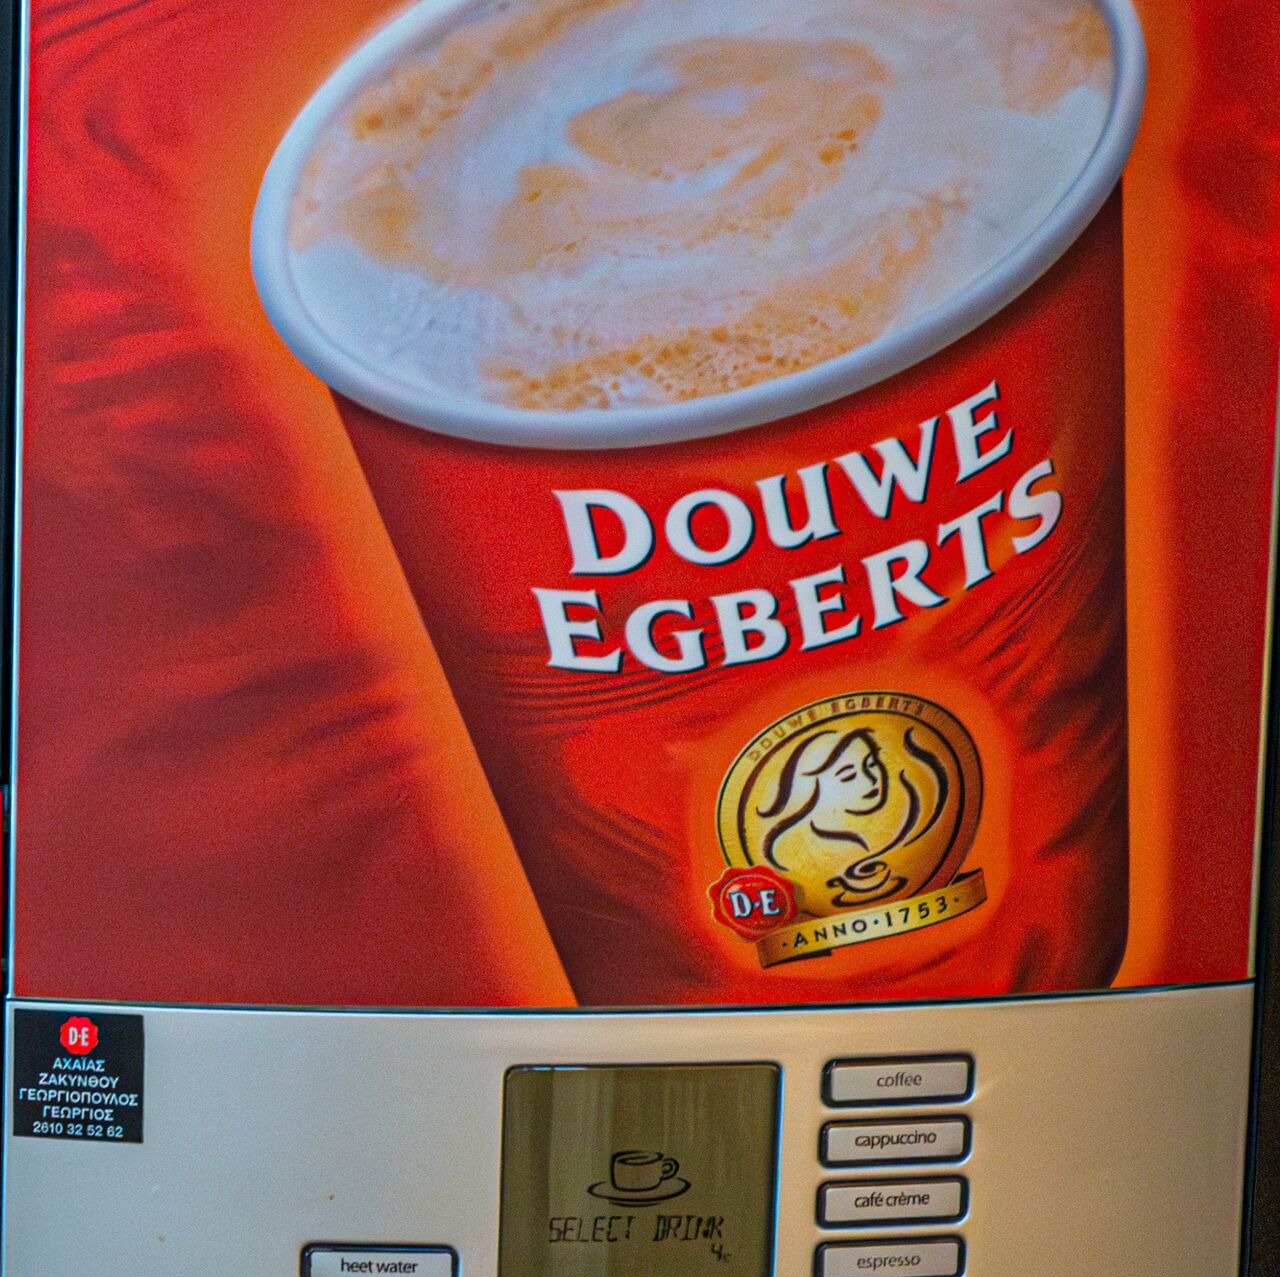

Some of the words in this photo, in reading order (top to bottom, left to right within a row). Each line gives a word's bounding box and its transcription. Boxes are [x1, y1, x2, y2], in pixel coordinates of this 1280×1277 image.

[551, 379, 1014, 577] DOUWE
[530, 457, 1064, 674] EGBERTS
[38, 1072, 119, 1089] ΖΑΚΥΝΘΟΥ
[876, 1071, 923, 1088] coffee
[19, 1088, 139, 1106] ΓΕΩΡΓΙΟΠΟΥΛΟΣ
[42, 1105, 115, 1121] ΓΕΩΡΓΙΟΣ
[32, 1121, 63, 1134] 2610
[66, 1123, 83, 1135] 32
[86, 1124, 103, 1137] 52
[106, 1126, 124, 1138] 62
[854, 1129, 937, 1150] cappuccino
[854, 1191, 884, 1209] café
[886, 1192, 931, 1207] crème
[548, 1214, 636, 1243] SELECT
[652, 1214, 725, 1242] DRINK
[340, 1258, 373, 1274] heet
[376, 1259, 420, 1274] water
[856, 1254, 922, 1271] espresso
